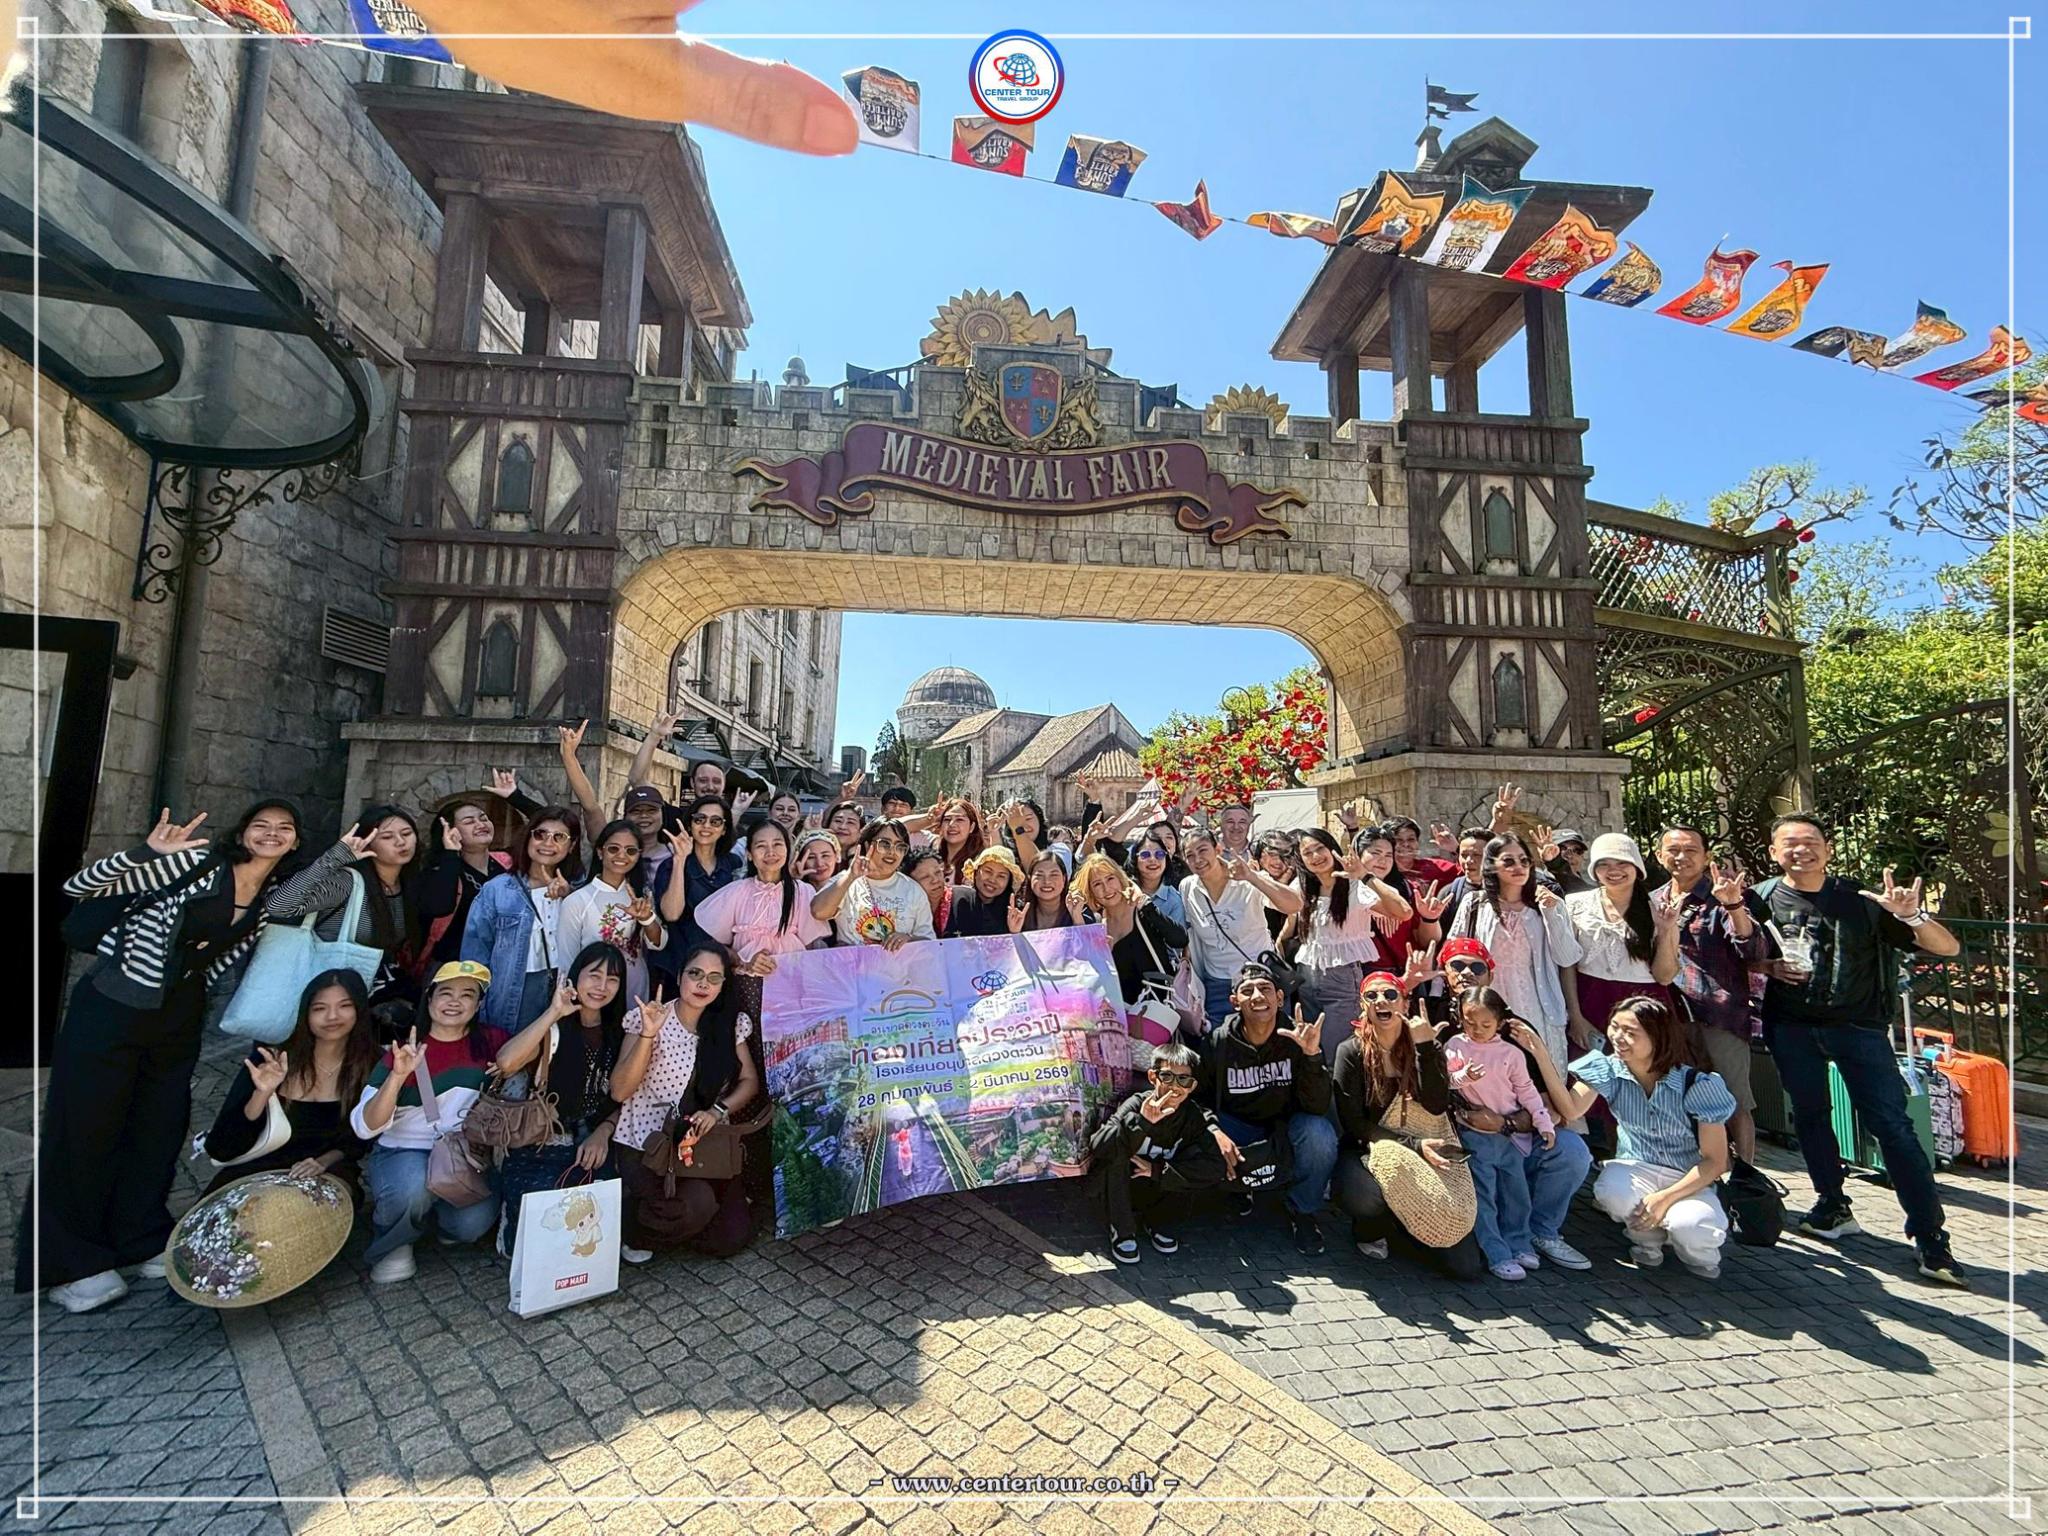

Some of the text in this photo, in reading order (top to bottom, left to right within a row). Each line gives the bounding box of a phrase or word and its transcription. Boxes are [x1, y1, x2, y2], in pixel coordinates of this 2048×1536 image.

[880, 431, 1175, 501] MEDIEVAL FAIR
[858, 1093, 876, 1109] 28
[881, 1079, 954, 1105] กุมภาพันธ์
[969, 1078, 979, 1090] 2
[983, 1071, 1030, 1087] มีนาคม
[1035, 1065, 1069, 1080] 2569
